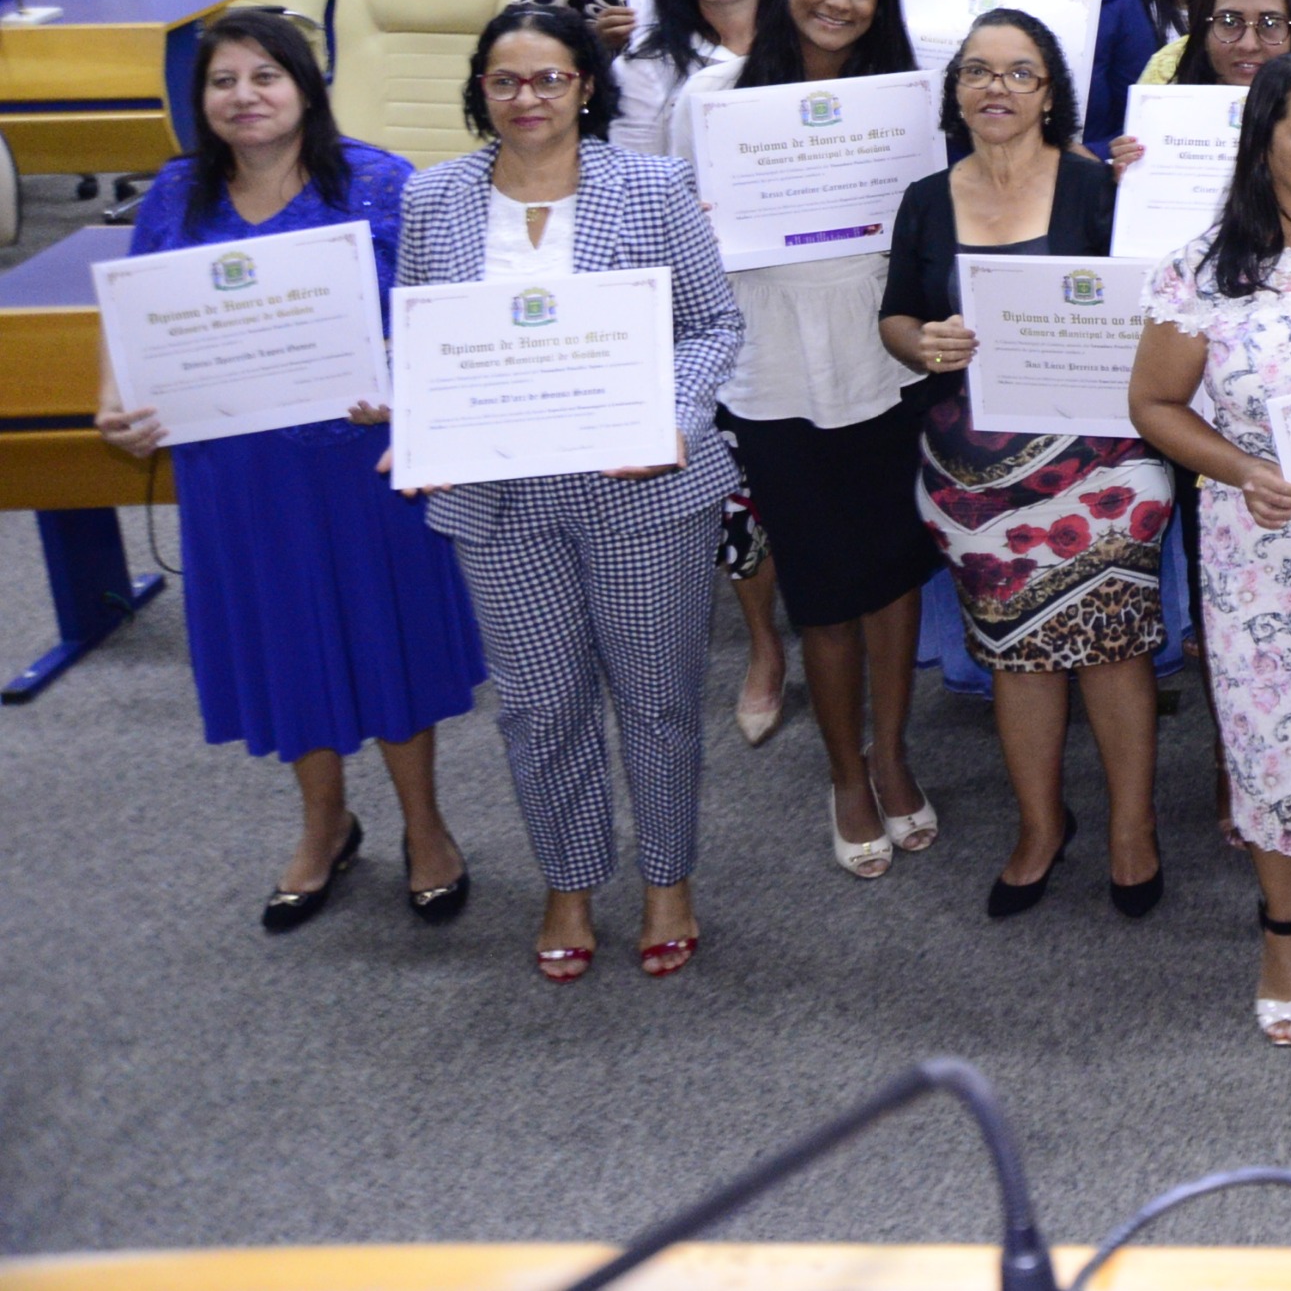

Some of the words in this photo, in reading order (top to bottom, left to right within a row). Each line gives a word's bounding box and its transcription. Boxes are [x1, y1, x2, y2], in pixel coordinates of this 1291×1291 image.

[738, 141, 788, 154] Diploma
[791, 137, 805, 148] de
[808, 134, 846, 146] Honra
[849, 132, 863, 141] ao
[867, 127, 906, 139] Mérito
[757, 155, 794, 166] Câmara
[796, 149, 841, 161] Municipal
[844, 148, 854, 156] de
[856, 144, 891, 154] Goiânia
[1002, 310, 1050, 325] Diploma
[1054, 313, 1066, 324] de
[1070, 313, 1107, 326] Honra
[1111, 316, 1125, 326] ao
[440, 342, 495, 355] Diploma
[500, 338, 513, 350] de
[518, 336, 560, 349] Honra
[564, 335, 579, 344] ao
[584, 329, 628, 343] Mérito
[1020, 326, 1055, 337] Câmara
[1058, 328, 1102, 340] Municipal
[1106, 331, 1114, 339] de
